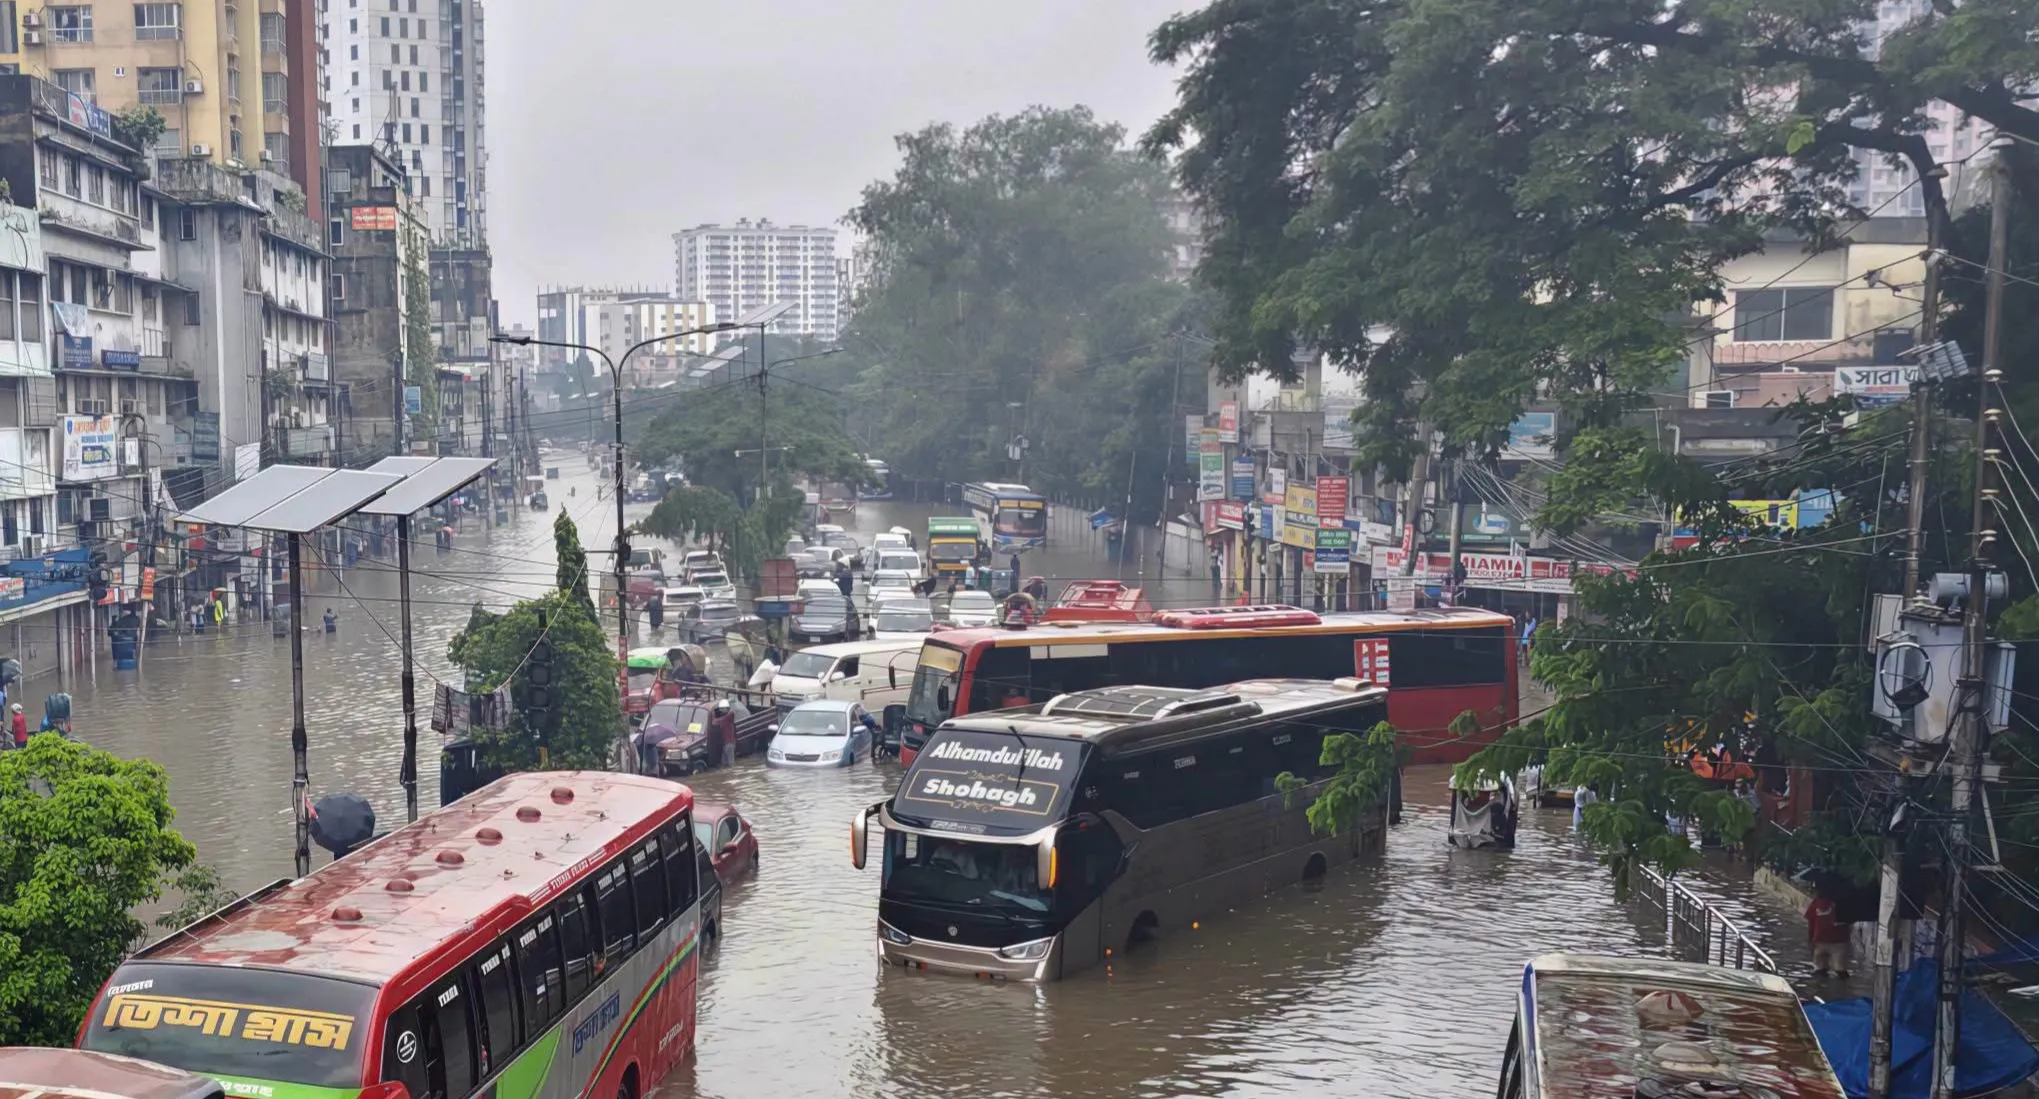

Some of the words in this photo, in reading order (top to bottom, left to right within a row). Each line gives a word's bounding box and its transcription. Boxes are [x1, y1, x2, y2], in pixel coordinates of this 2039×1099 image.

[1855, 369, 1900, 385] সাবা
[929, 741, 1064, 771] Alhamdulillah
[923, 778, 1037, 806] Shohagh
[103, 994, 240, 1037] তিশা
[242, 1004, 355, 1051] প্লাস
